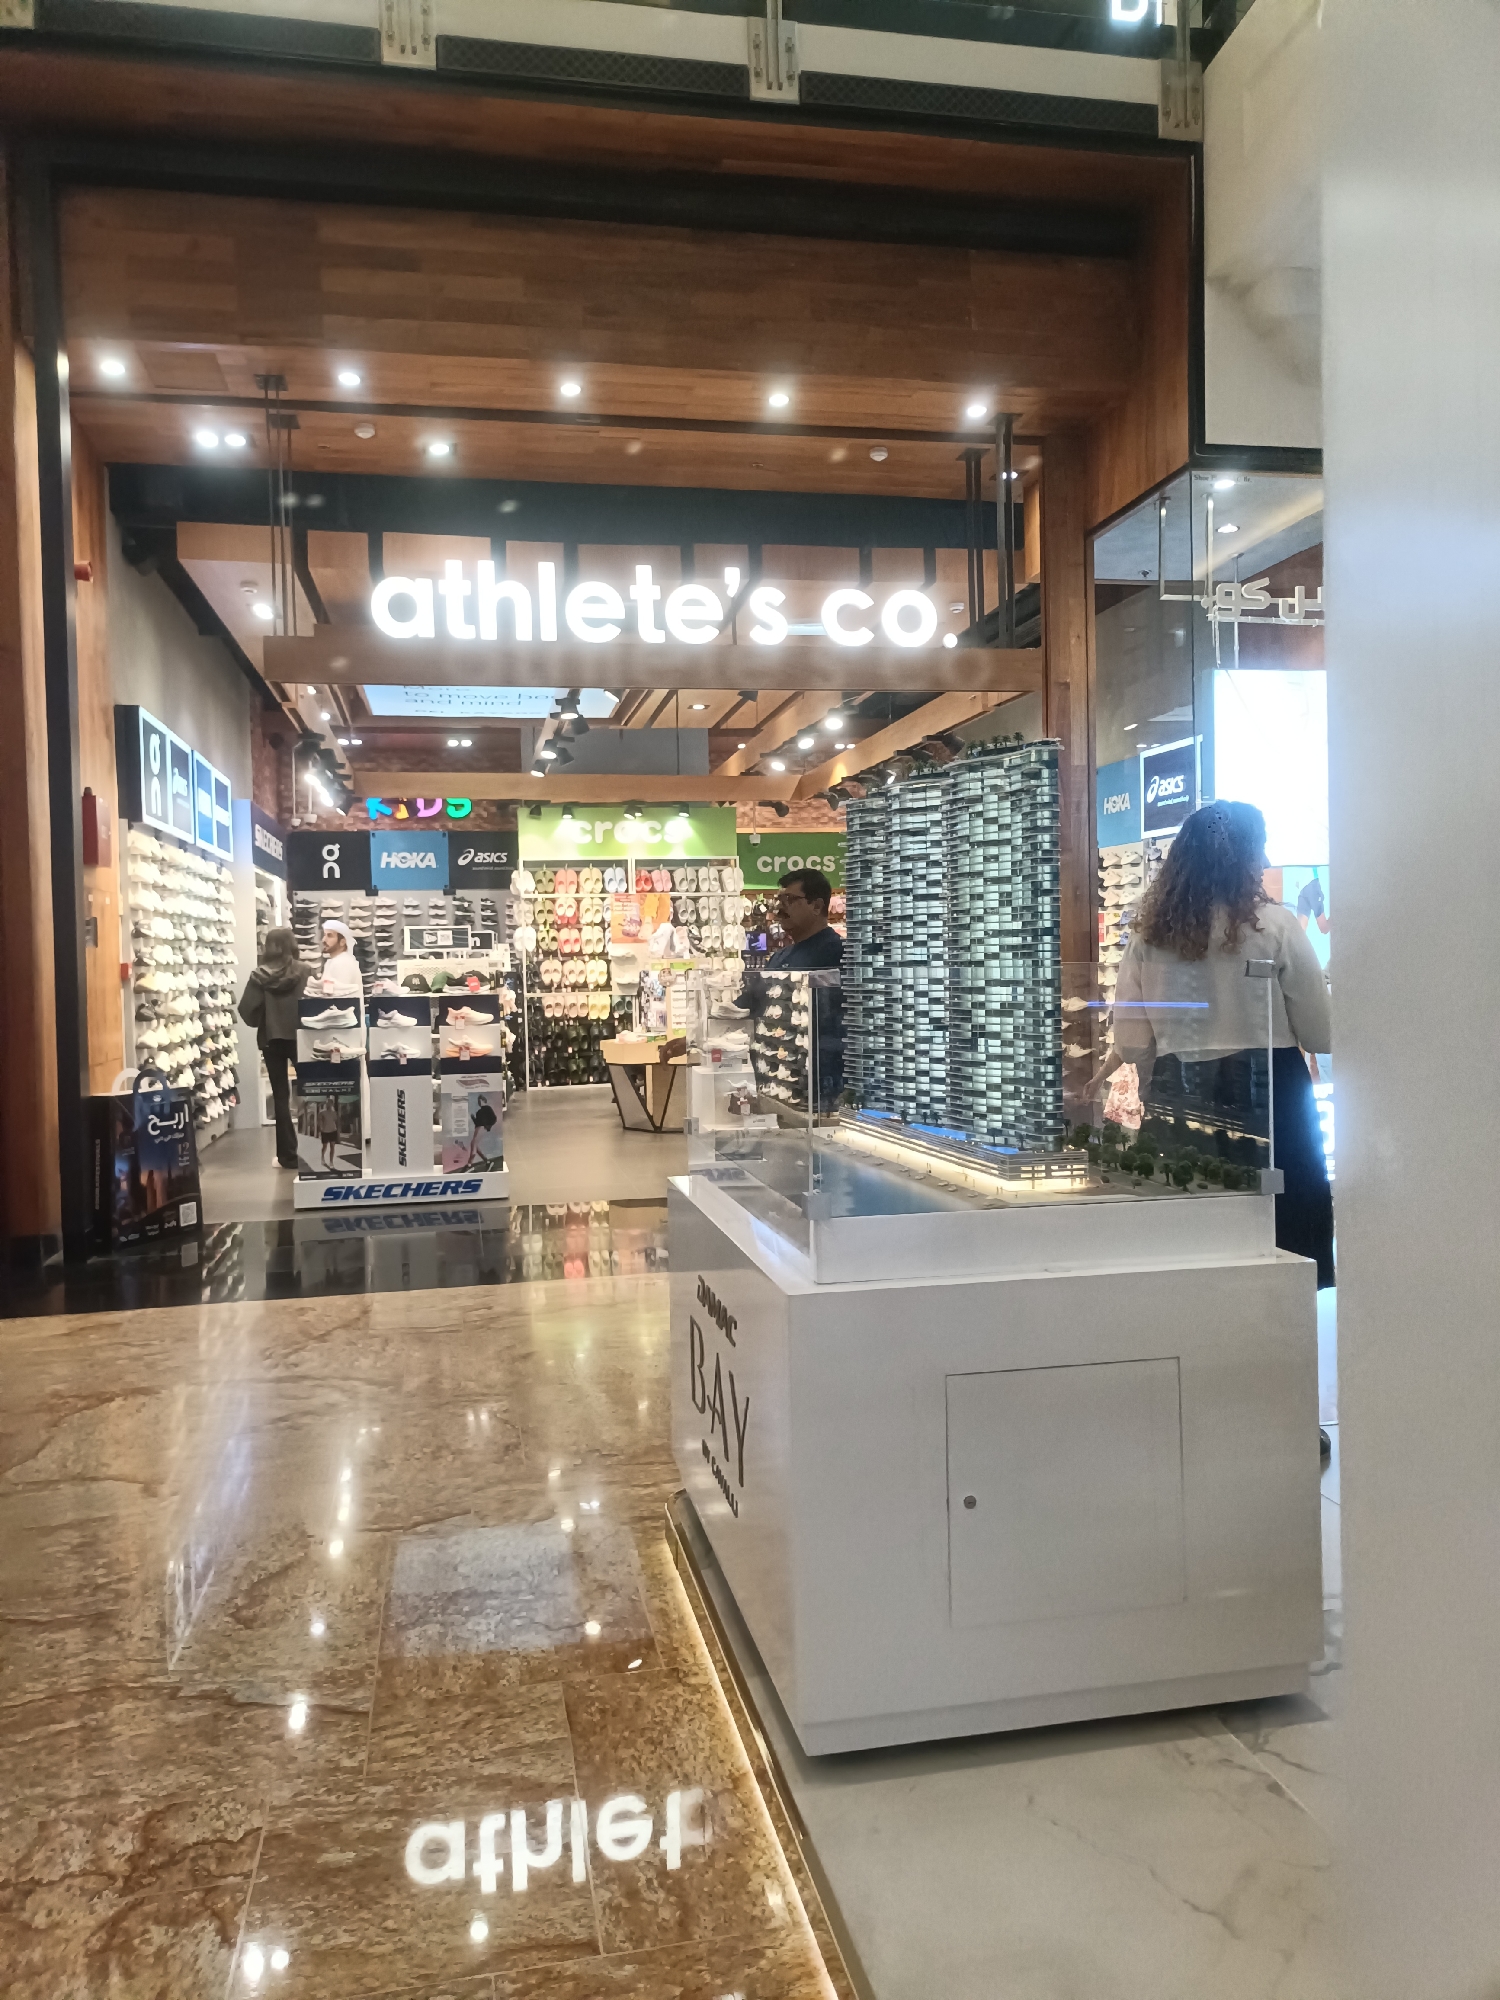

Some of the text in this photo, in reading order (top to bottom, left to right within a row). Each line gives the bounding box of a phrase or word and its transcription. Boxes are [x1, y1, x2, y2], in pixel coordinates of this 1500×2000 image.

[371, 559, 959, 648] athlete's co.
[1158, 775, 1184, 796] asics
[1103, 793, 1131, 815] HOKA
[571, 820, 688, 844] crocs
[380, 852, 437, 869] HOKA
[474, 852, 507, 863] asics
[756, 854, 836, 873] crocs
[397, 1089, 407, 1167] SKECHERS
[321, 1178, 483, 1202] SKECHERS
[697, 1274, 738, 1348] DAMAC
[690, 1314, 750, 1488] BAY
